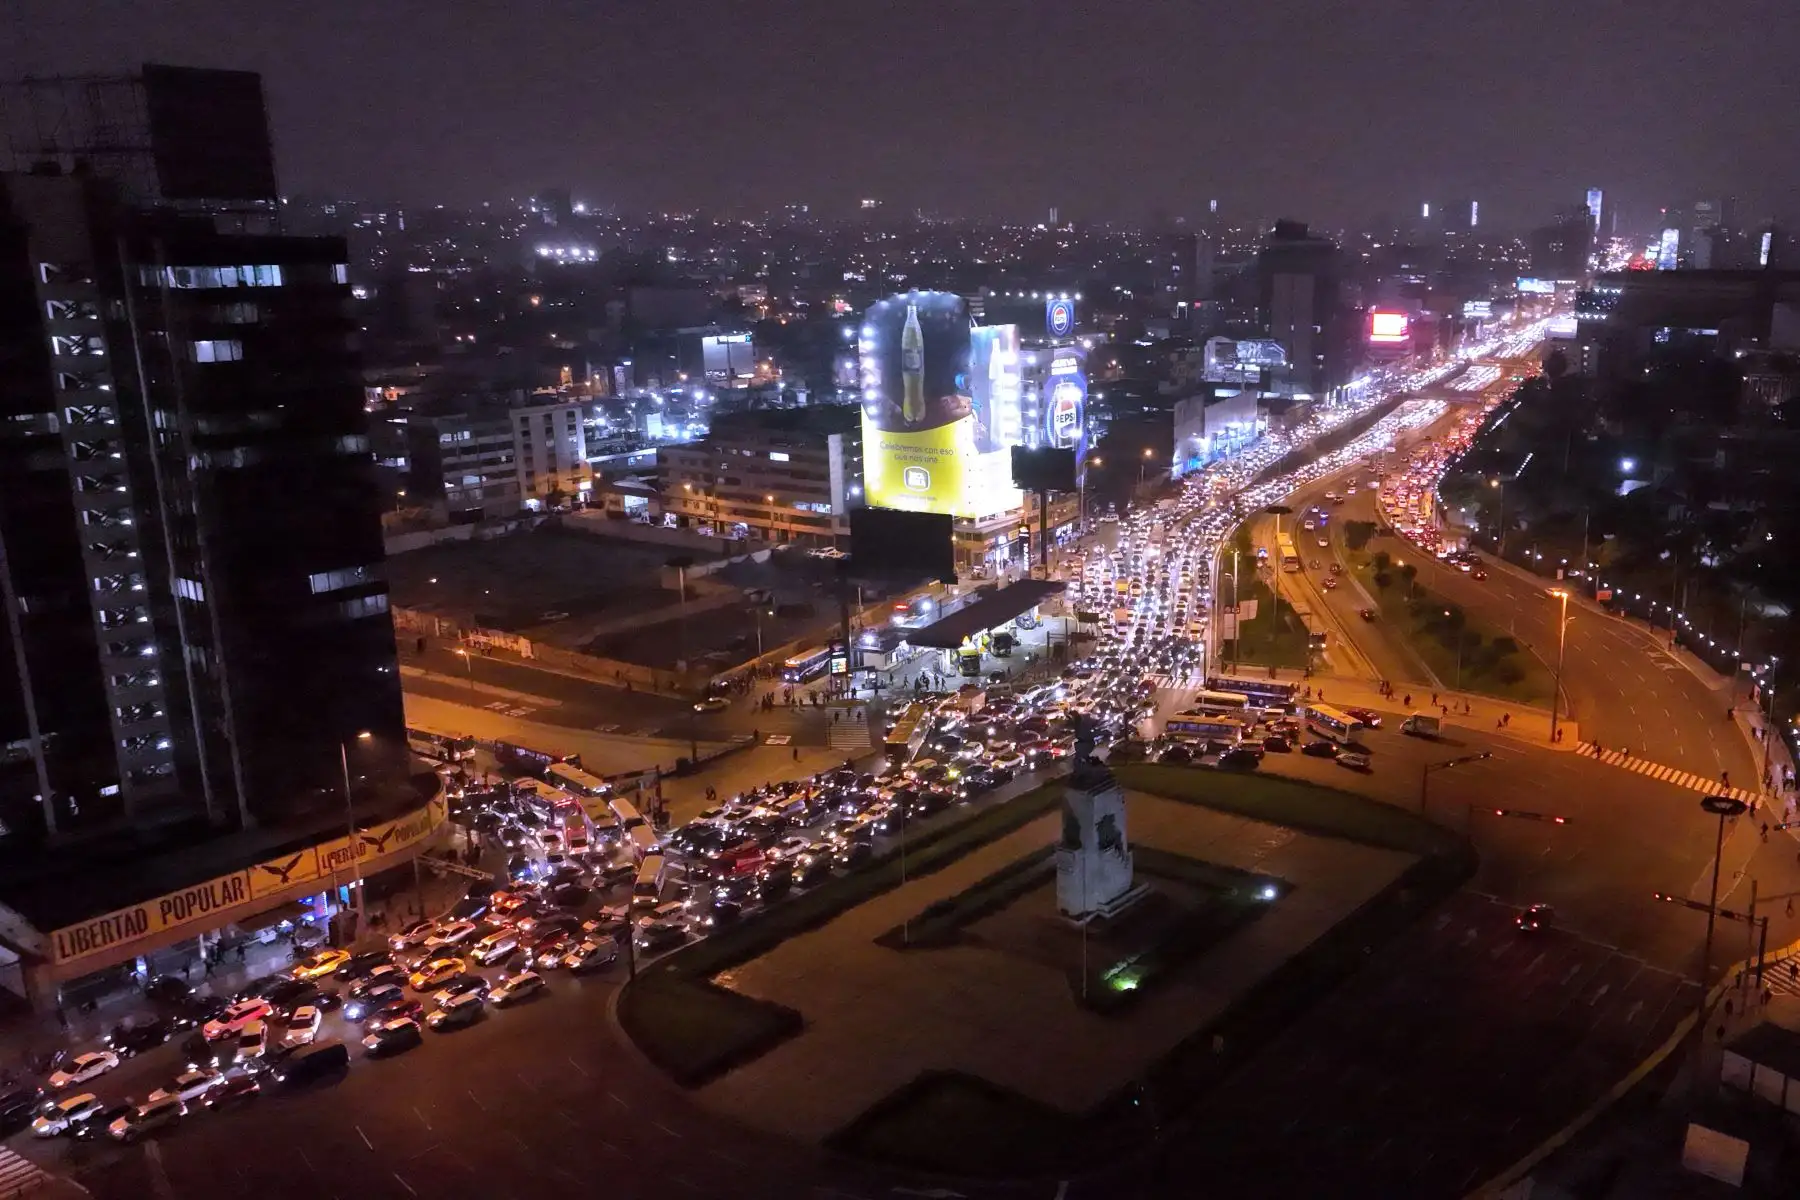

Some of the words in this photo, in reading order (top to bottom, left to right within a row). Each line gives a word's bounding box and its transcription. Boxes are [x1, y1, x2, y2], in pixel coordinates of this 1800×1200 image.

[924, 447, 938, 455] con
[939, 448, 954, 456] eso
[58, 908, 149, 960] LIBERTAD
[160, 877, 245, 925] POPULAR
